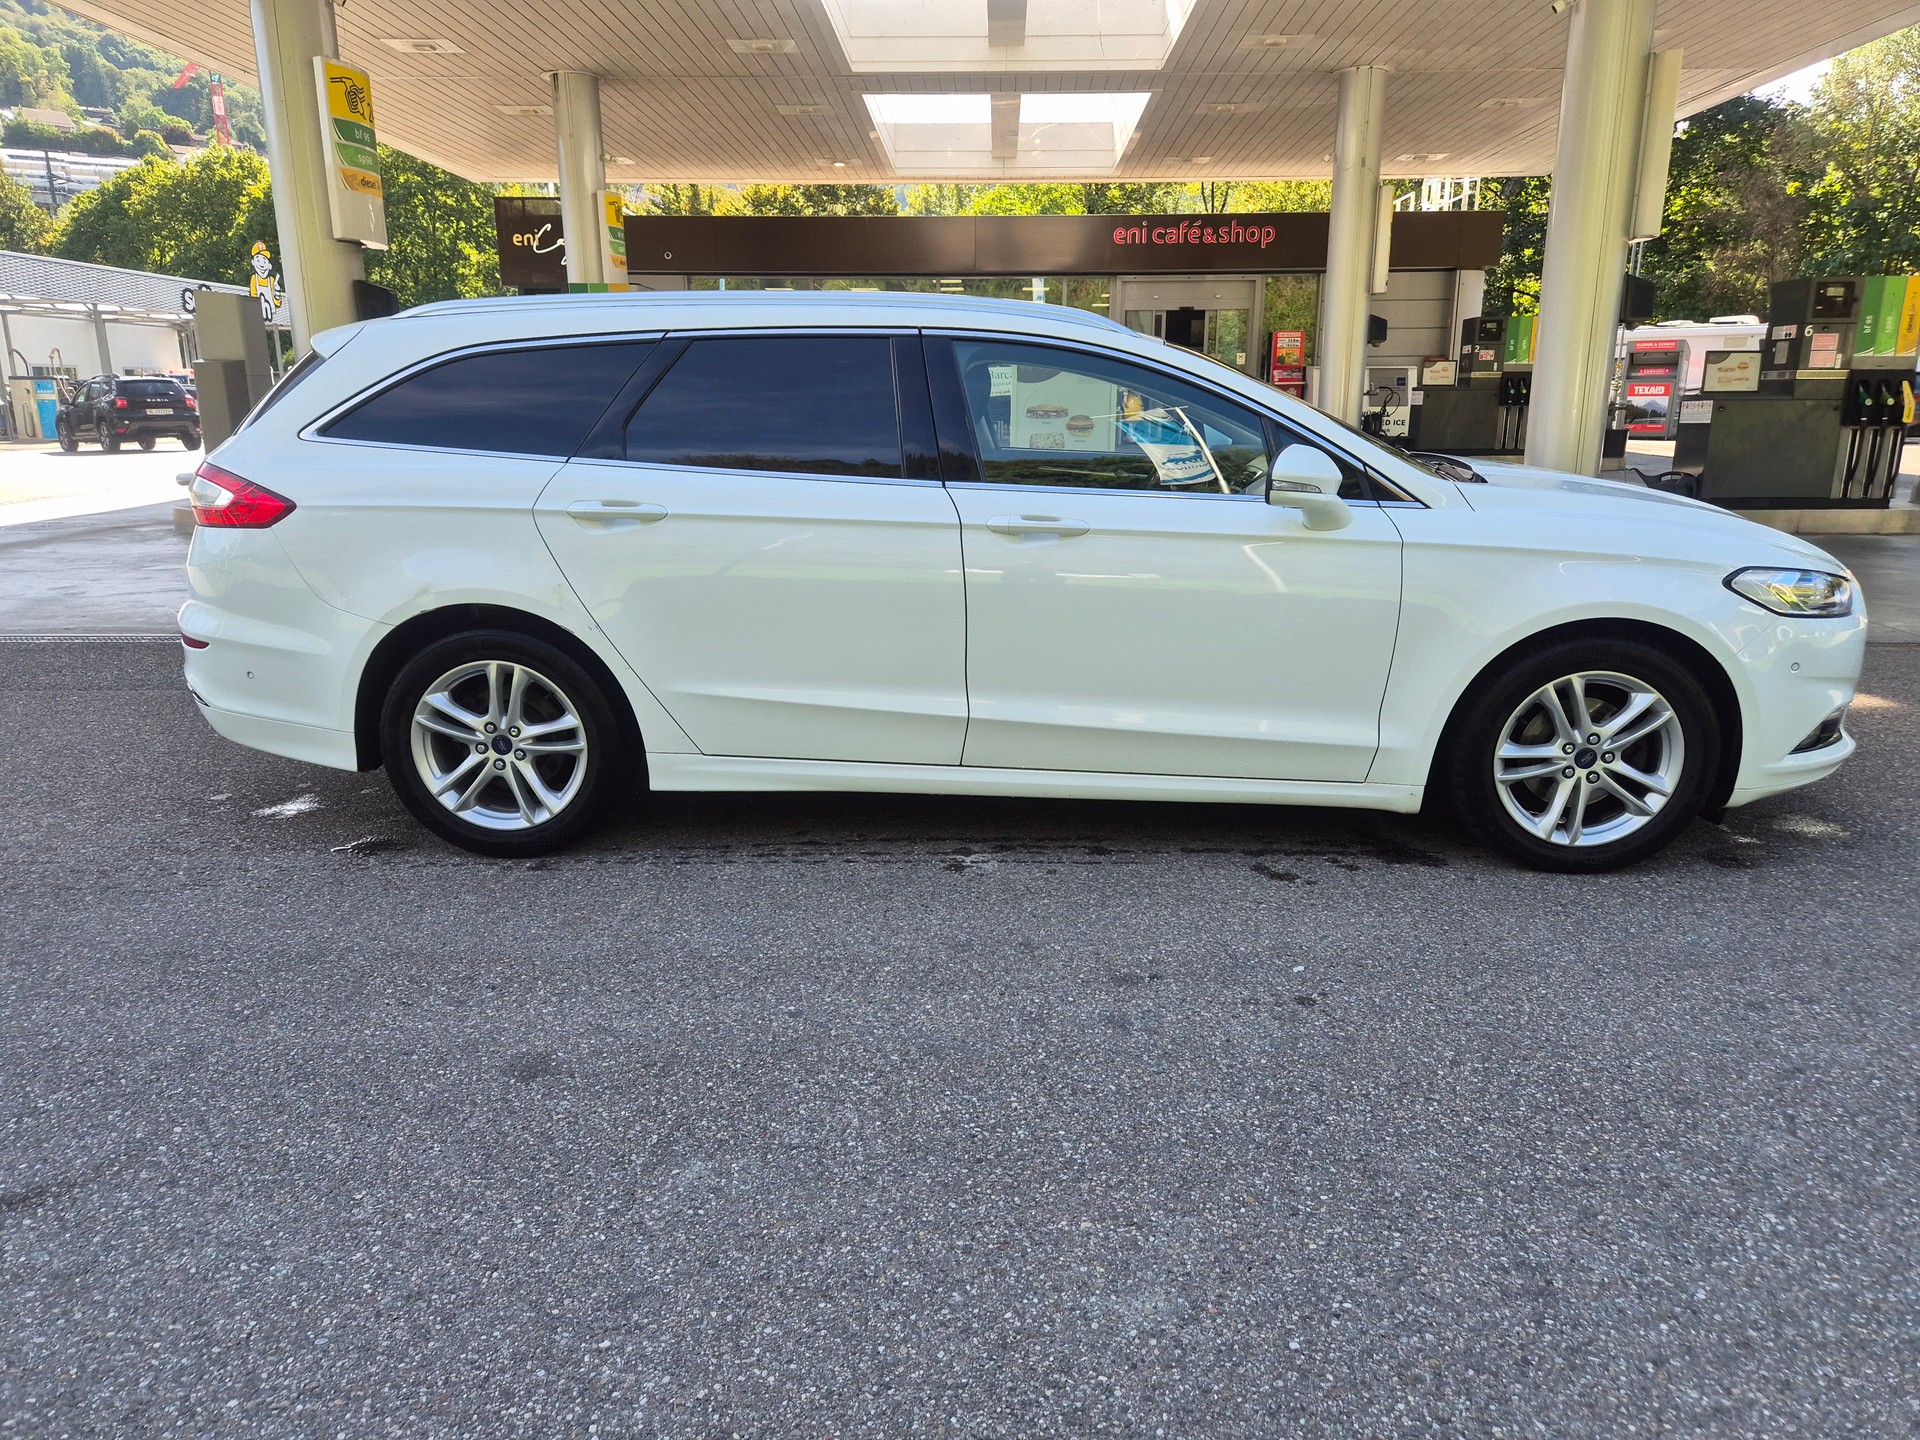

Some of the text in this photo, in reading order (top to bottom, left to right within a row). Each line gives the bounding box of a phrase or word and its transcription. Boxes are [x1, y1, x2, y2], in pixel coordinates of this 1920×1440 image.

[355, 128, 370, 143] bf 95
[512, 228, 540, 247] eni
[1113, 220, 1149, 245] eni
[1804, 324, 1814, 337] 6
[1474, 344, 1480, 353] 2
[1634, 386, 1665, 395] TEXAID
